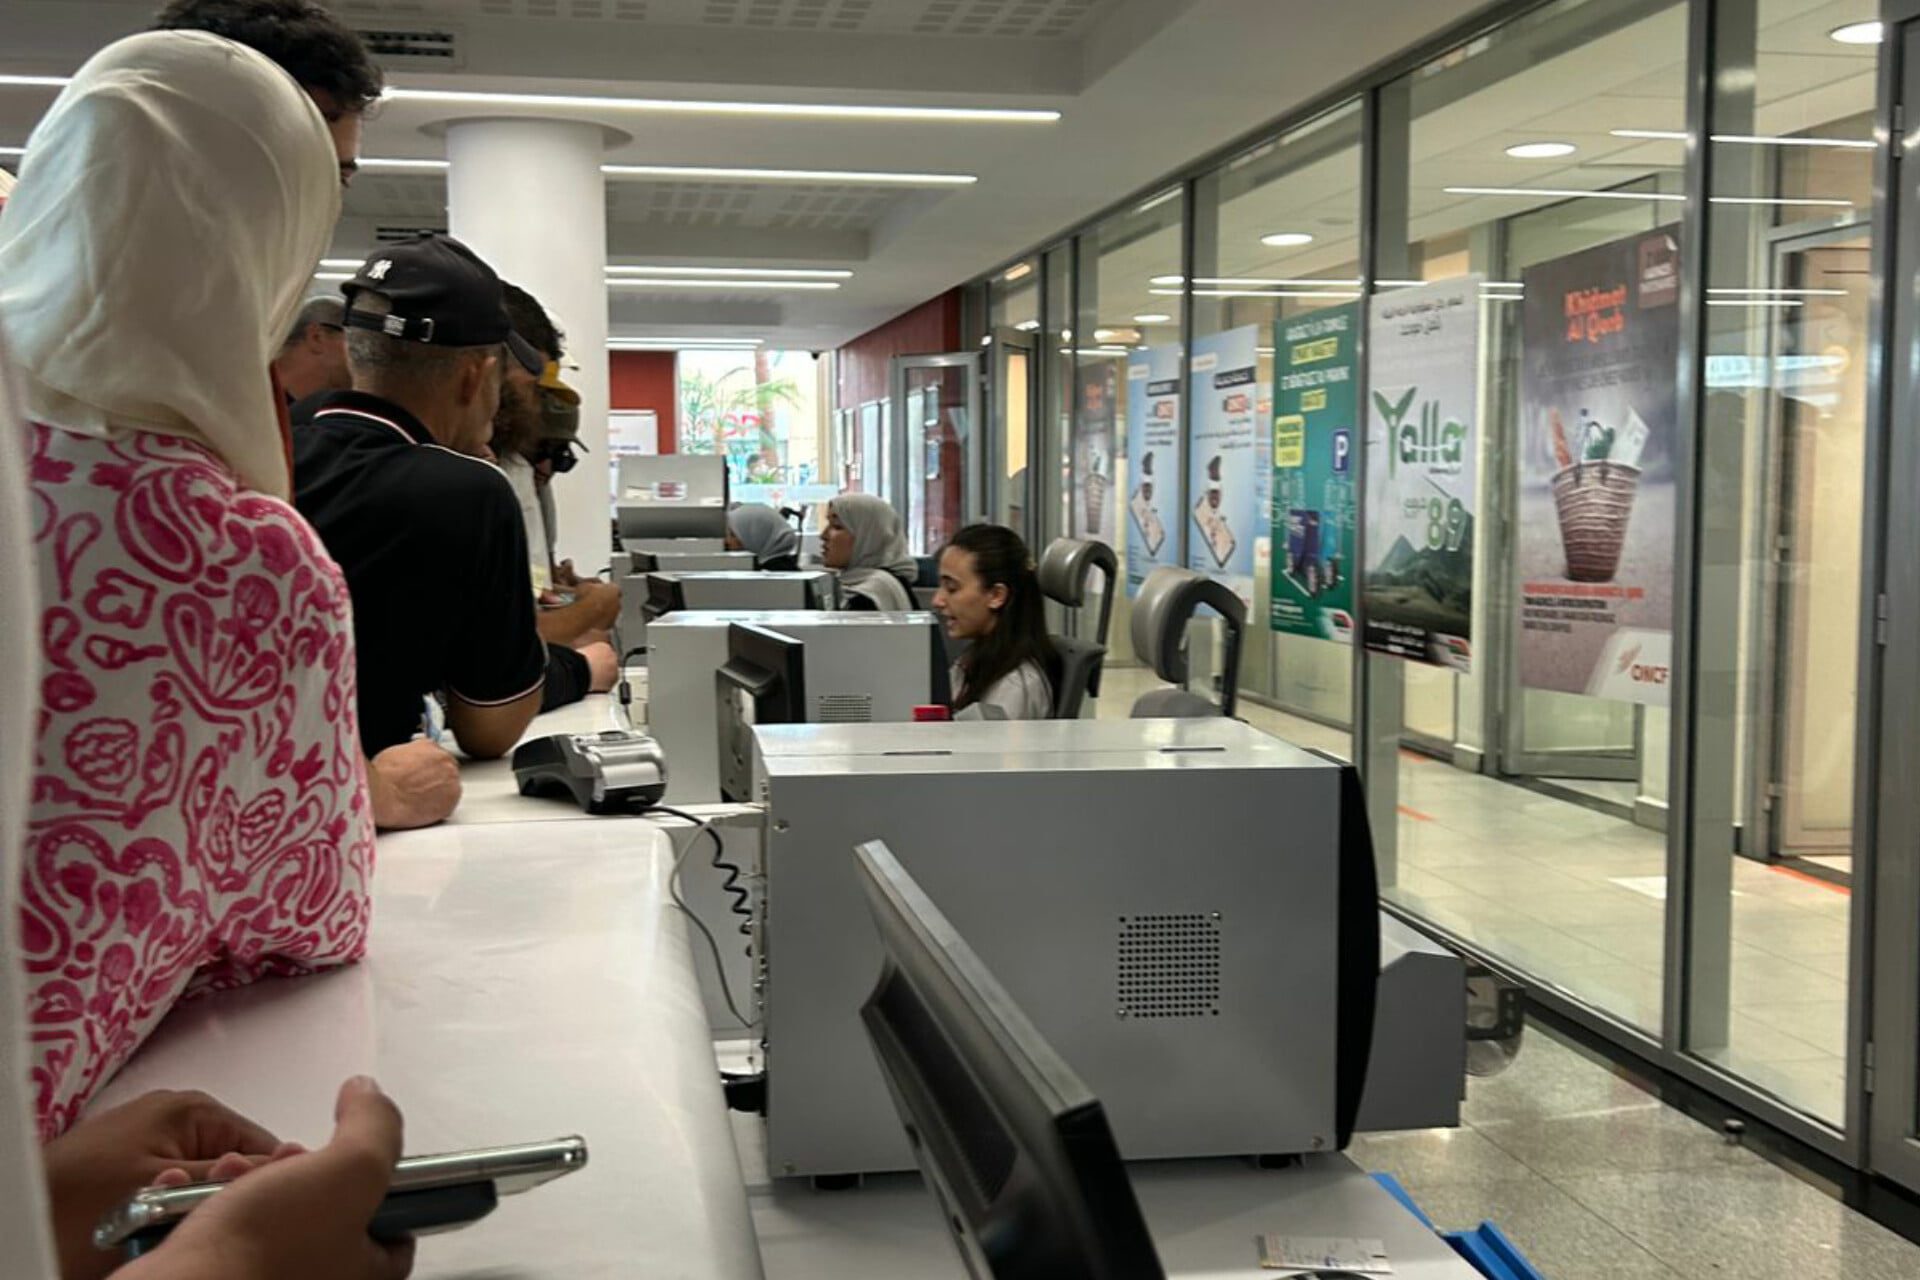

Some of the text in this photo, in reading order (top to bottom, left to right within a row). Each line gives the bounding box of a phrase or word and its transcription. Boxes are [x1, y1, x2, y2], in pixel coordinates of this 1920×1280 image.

[1335, 434, 1349, 469] P
[1373, 386, 1467, 480] Yalla
[1427, 497, 1467, 551] 89
[1631, 664, 1668, 685] ONCF
